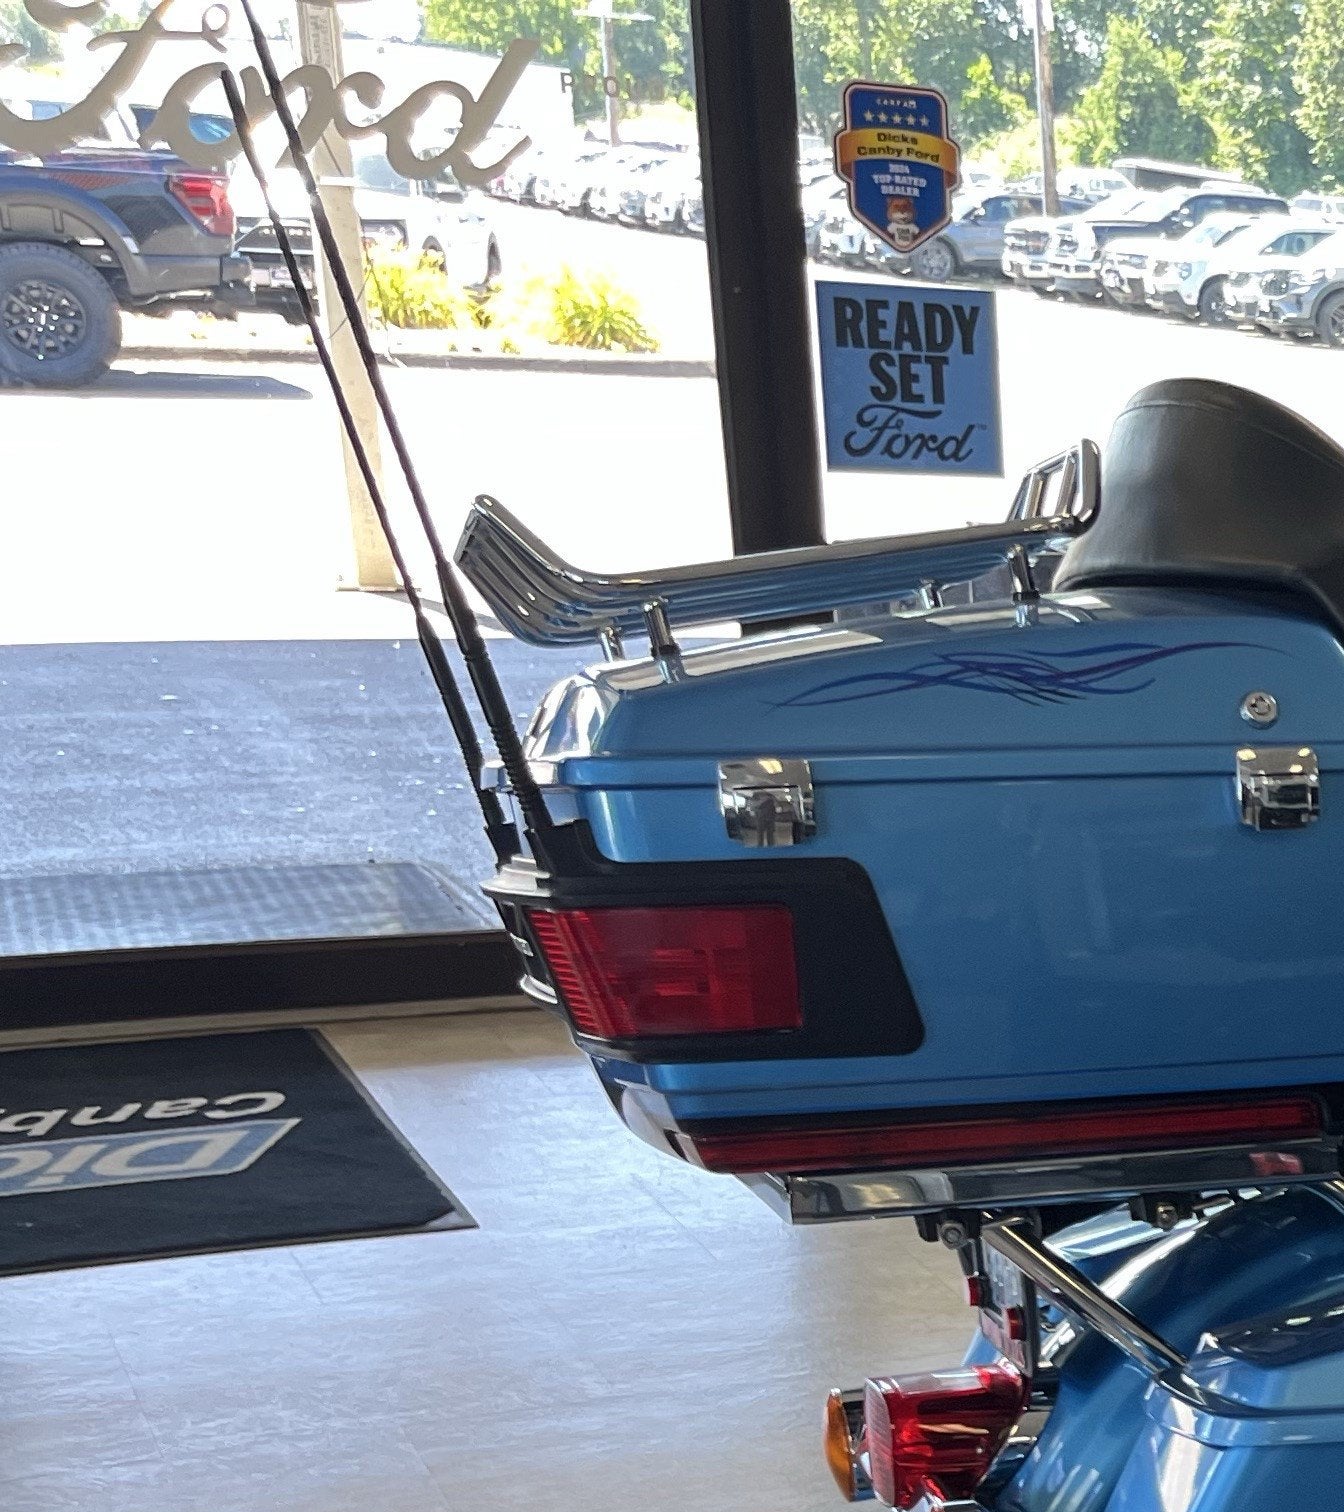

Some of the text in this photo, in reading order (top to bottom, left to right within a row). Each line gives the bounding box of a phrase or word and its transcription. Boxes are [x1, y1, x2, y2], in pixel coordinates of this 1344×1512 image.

[857, 145, 941, 164] Canby Ford
[833, 296, 980, 355] READY
[868, 352, 949, 405] SET
[844, 403, 974, 462] Ford
[0, 1091, 286, 1136] Canb
